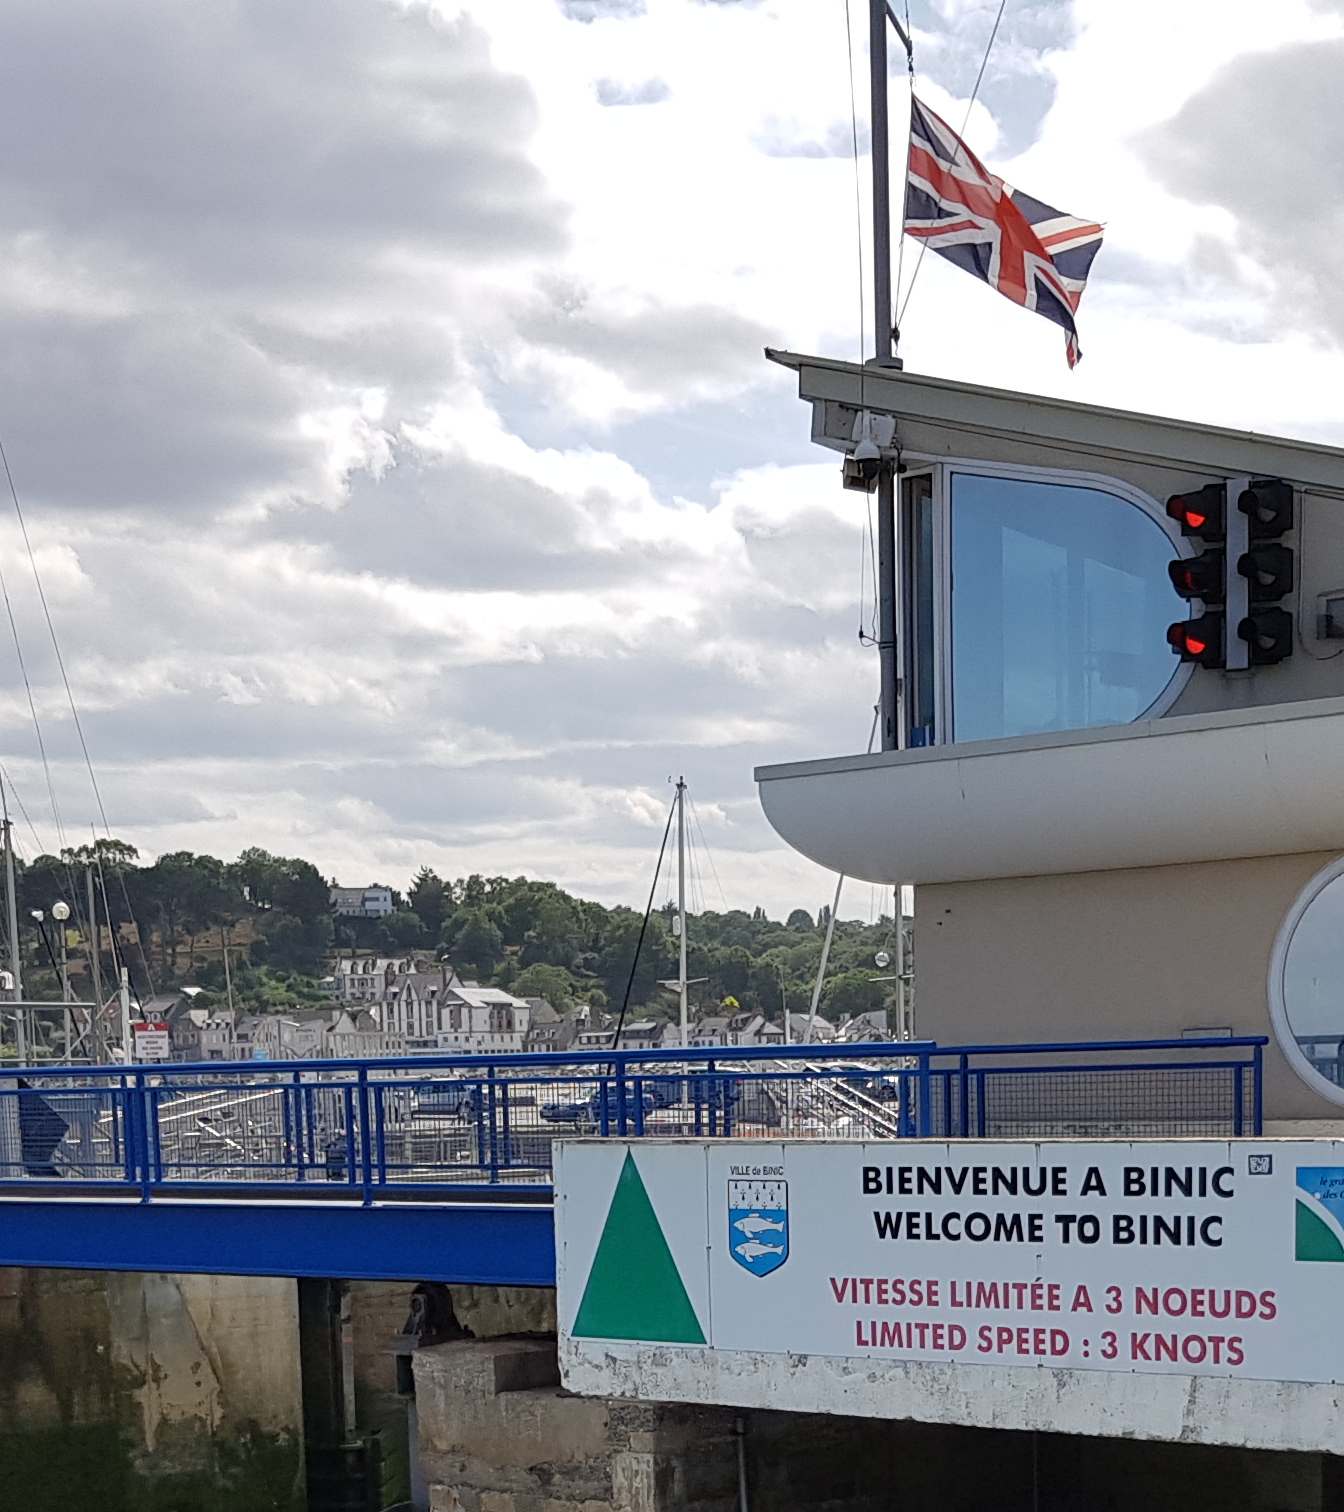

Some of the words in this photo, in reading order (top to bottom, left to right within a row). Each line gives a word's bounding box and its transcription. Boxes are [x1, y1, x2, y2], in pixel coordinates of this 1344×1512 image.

[729, 1165, 751, 1176] VILLE
[752, 1165, 761, 1176] de
[762, 1165, 784, 1176] BINIC
[862, 1166, 1067, 1197] BIENVENUE
[1080, 1166, 1107, 1197] A
[1123, 1166, 1235, 1198] BINIC
[1319, 1175, 1329, 1186] le
[1323, 1189, 1338, 1199] des
[873, 1211, 1044, 1243] WELCOME
[1055, 1214, 1100, 1244] TO
[1113, 1214, 1223, 1247] BINIC
[829, 1277, 940, 1307] VITESSE
[950, 1276, 1061, 1311] LIMITÉE
[1071, 1285, 1094, 1313] A
[1105, 1286, 1123, 1314] 3
[1135, 1286, 1277, 1320] NOEUDS
[856, 1320, 967, 1351] LIMITED
[977, 1325, 1070, 1356] SPEED
[1100, 1331, 1118, 1359] 3
[1131, 1332, 1245, 1366] KNOTS
